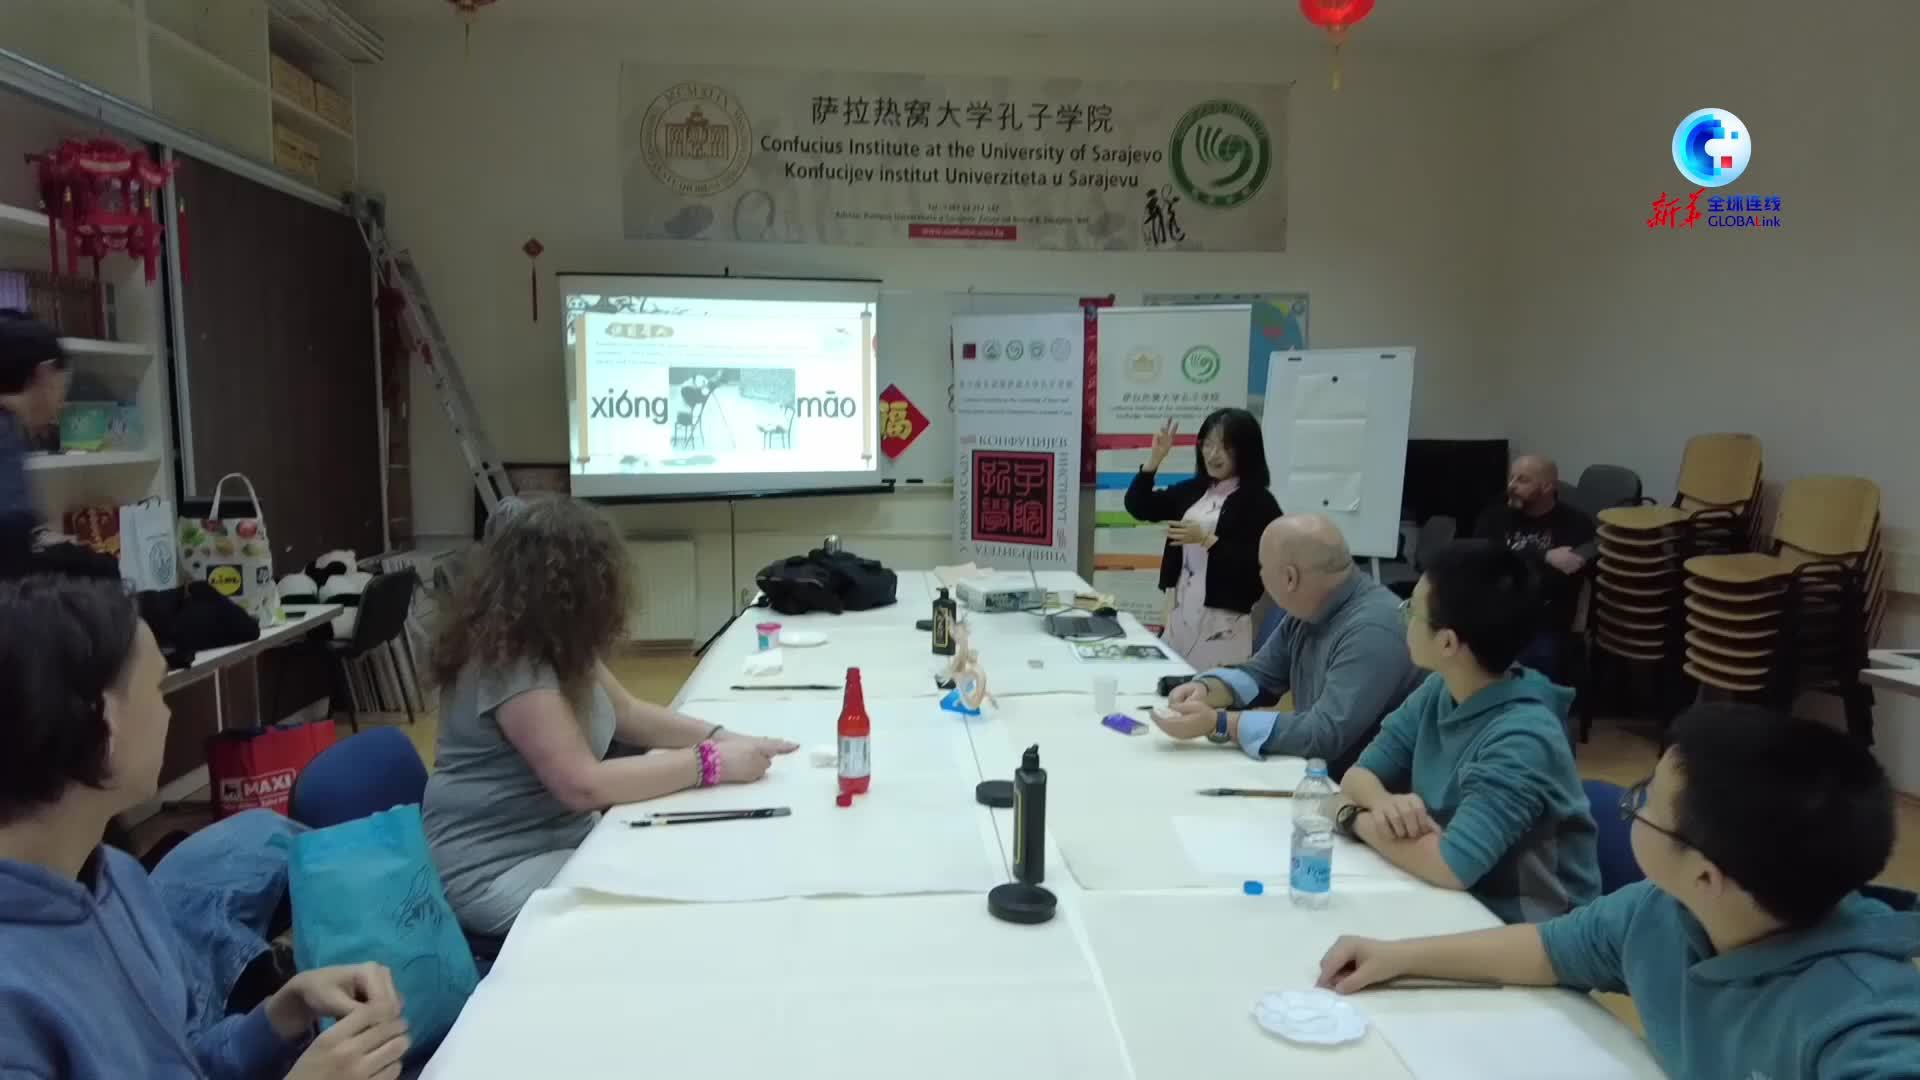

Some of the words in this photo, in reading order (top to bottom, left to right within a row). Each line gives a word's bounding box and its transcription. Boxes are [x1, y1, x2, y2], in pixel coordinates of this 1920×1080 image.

[811, 95, 1114, 134] 萨拉热窝大学孔子学院
[760, 135, 843, 154] Confucius
[849, 137, 920, 157] Institute
[925, 141, 942, 158] at
[948, 139, 975, 158] the
[981, 140, 1064, 164] University
[1070, 142, 1088, 162] of
[1092, 143, 1163, 166] Sarajevo
[785, 161, 874, 185] Konfucijev
[879, 163, 939, 184] institut
[945, 167, 1047, 187] Univerziteta
[1052, 173, 1063, 187] u
[1068, 169, 1139, 191] Sarajevu
[590, 388, 669, 424] xióng
[797, 391, 857, 418] māo
[243, 773, 292, 797] MAXI
